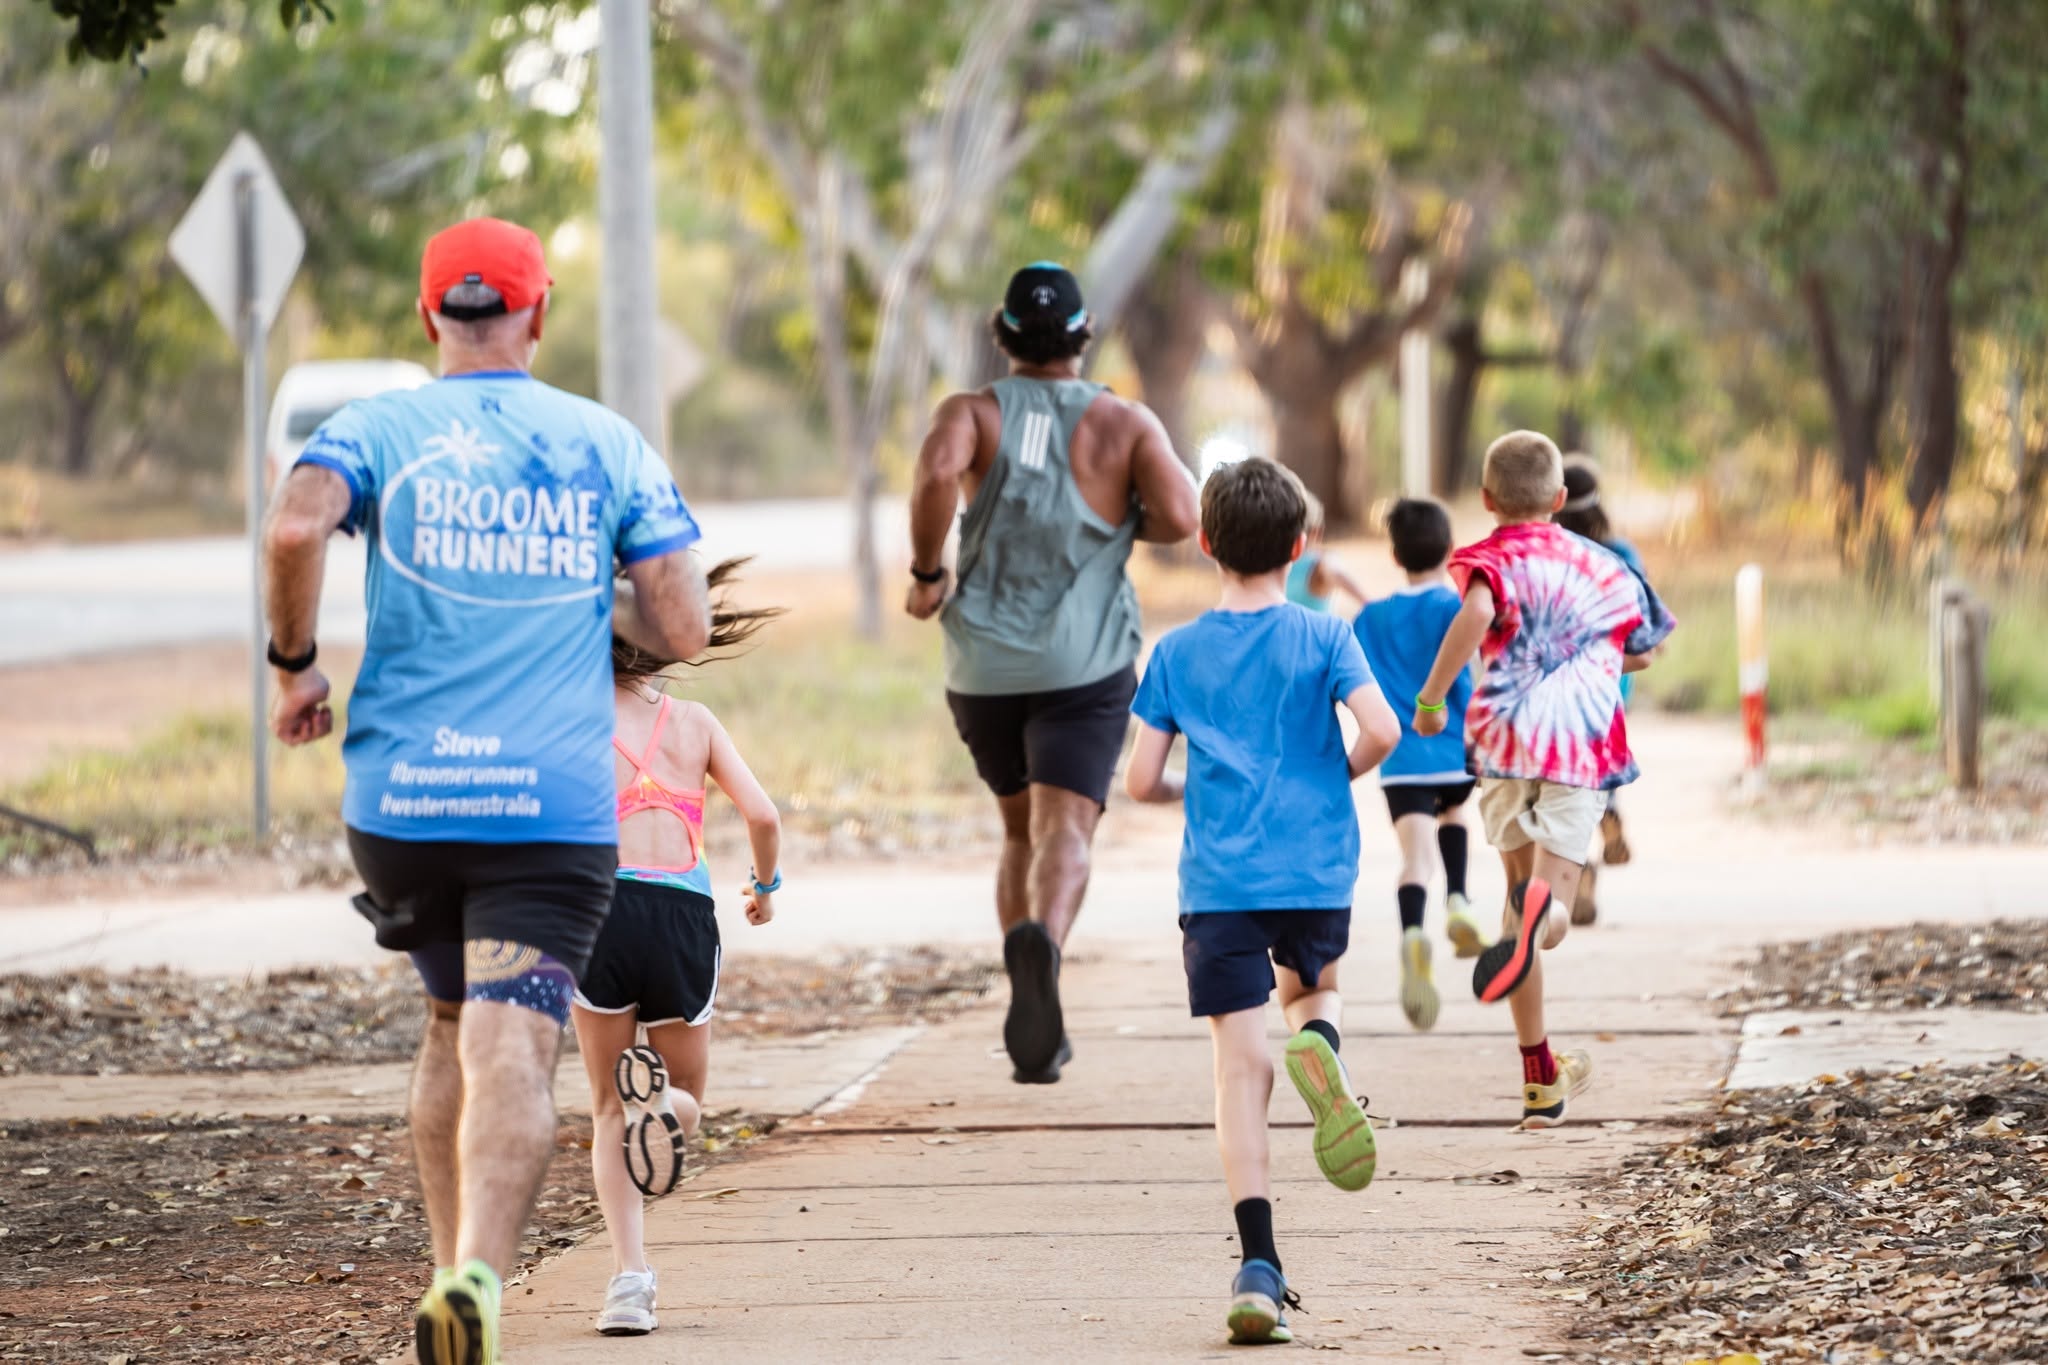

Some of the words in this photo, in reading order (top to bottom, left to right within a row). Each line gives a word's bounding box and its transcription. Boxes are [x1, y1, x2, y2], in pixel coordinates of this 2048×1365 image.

[415, 477, 598, 537] BROOME
[412, 525, 598, 580] RUNNERS
[432, 725, 501, 757] Steve
[389, 760, 538, 786] #broomerunners
[379, 791, 541, 818] #westernaustralia
